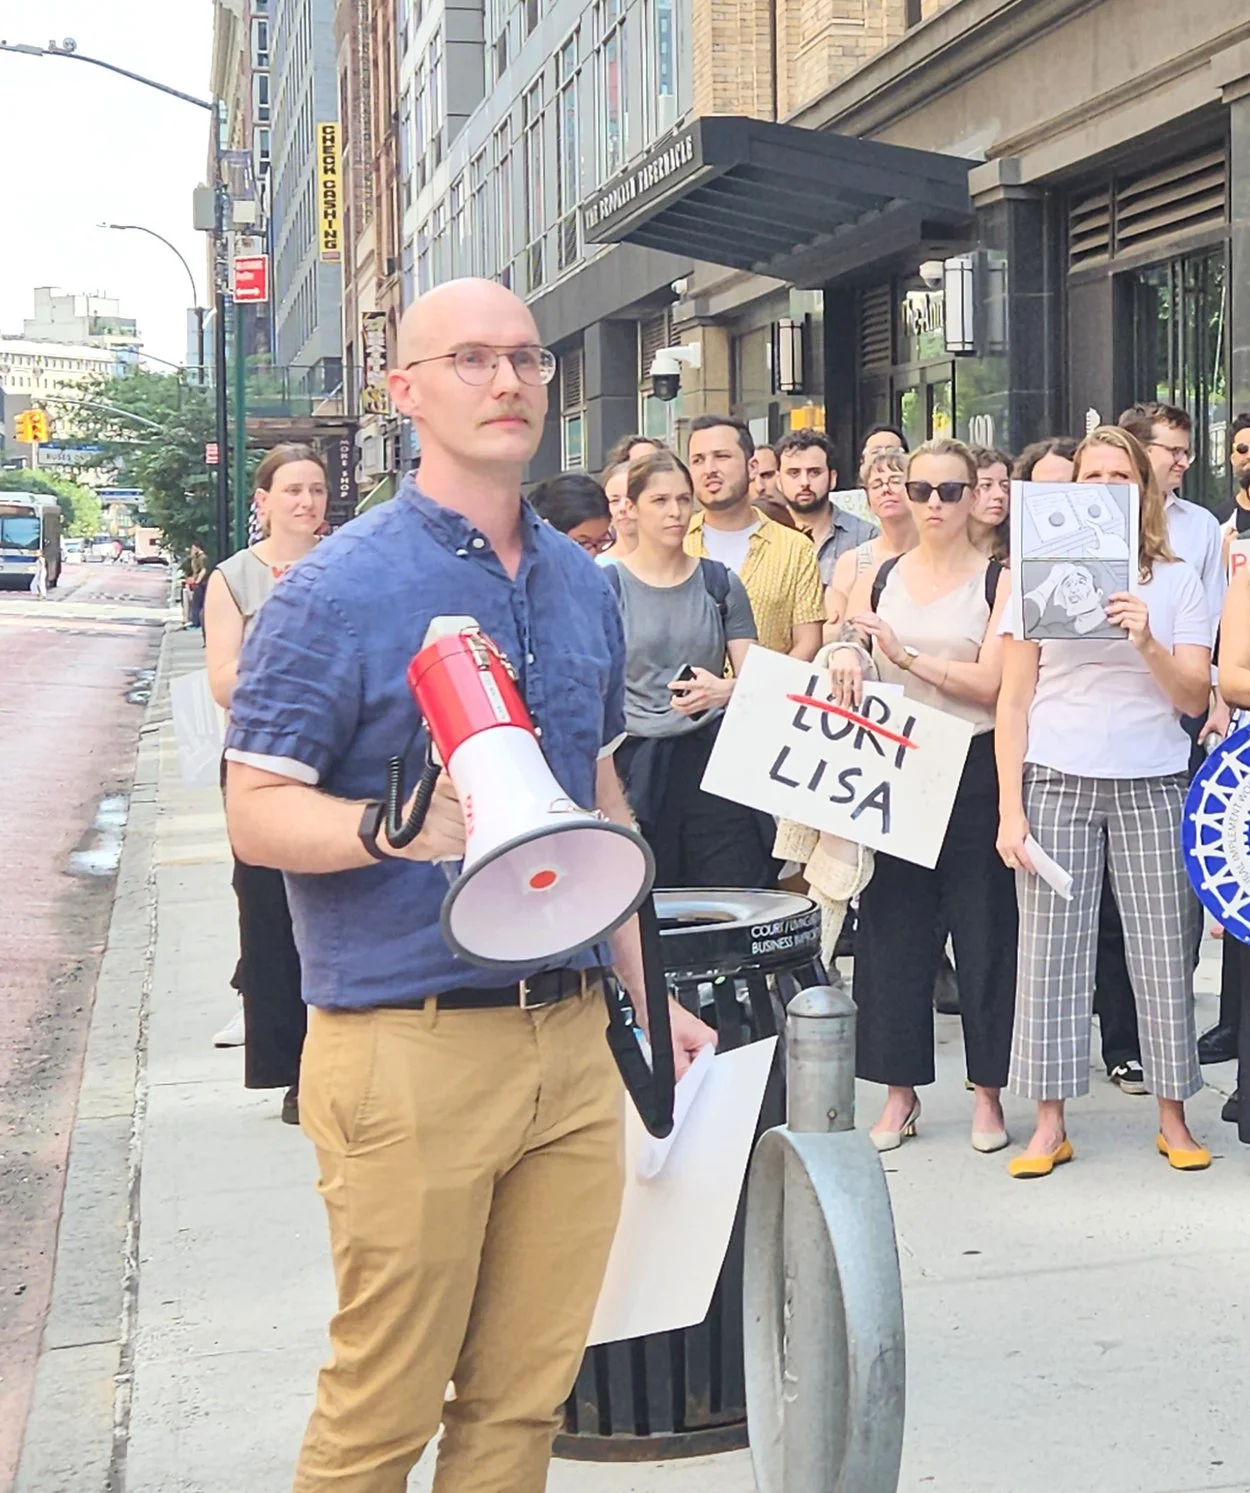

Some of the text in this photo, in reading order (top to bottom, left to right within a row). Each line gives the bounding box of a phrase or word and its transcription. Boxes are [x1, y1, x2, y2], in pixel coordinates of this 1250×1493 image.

[322, 125, 337, 249] CHECK CASHING
[790, 674, 917, 770] LORI
[769, 745, 891, 834] LISA
[1227, 803, 1241, 862] IMPLEMENT
[752, 936, 793, 955] BUSINESS
